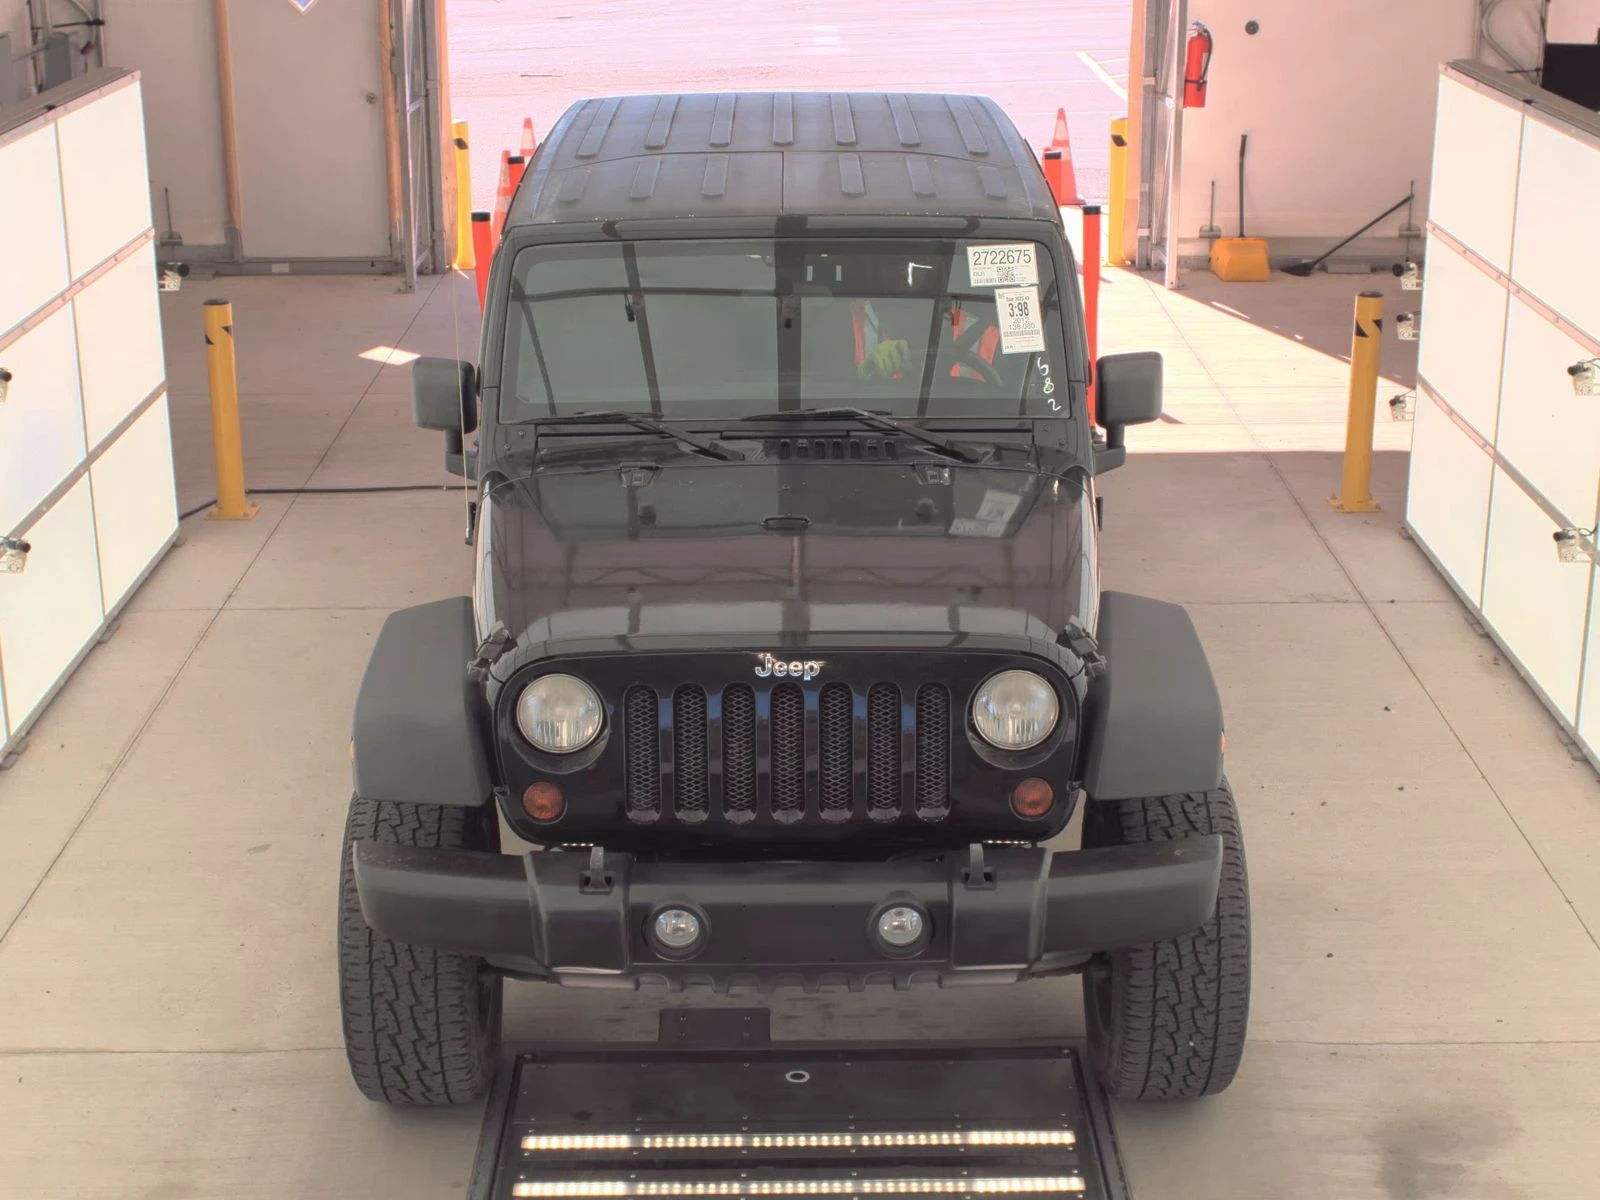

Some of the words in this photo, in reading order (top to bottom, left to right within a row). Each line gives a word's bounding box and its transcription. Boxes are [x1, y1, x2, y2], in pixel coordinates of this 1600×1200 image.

[973, 249, 1032, 266] 2722675
[1008, 301, 1030, 318] 3:98
[755, 653, 821, 681] Jeep
